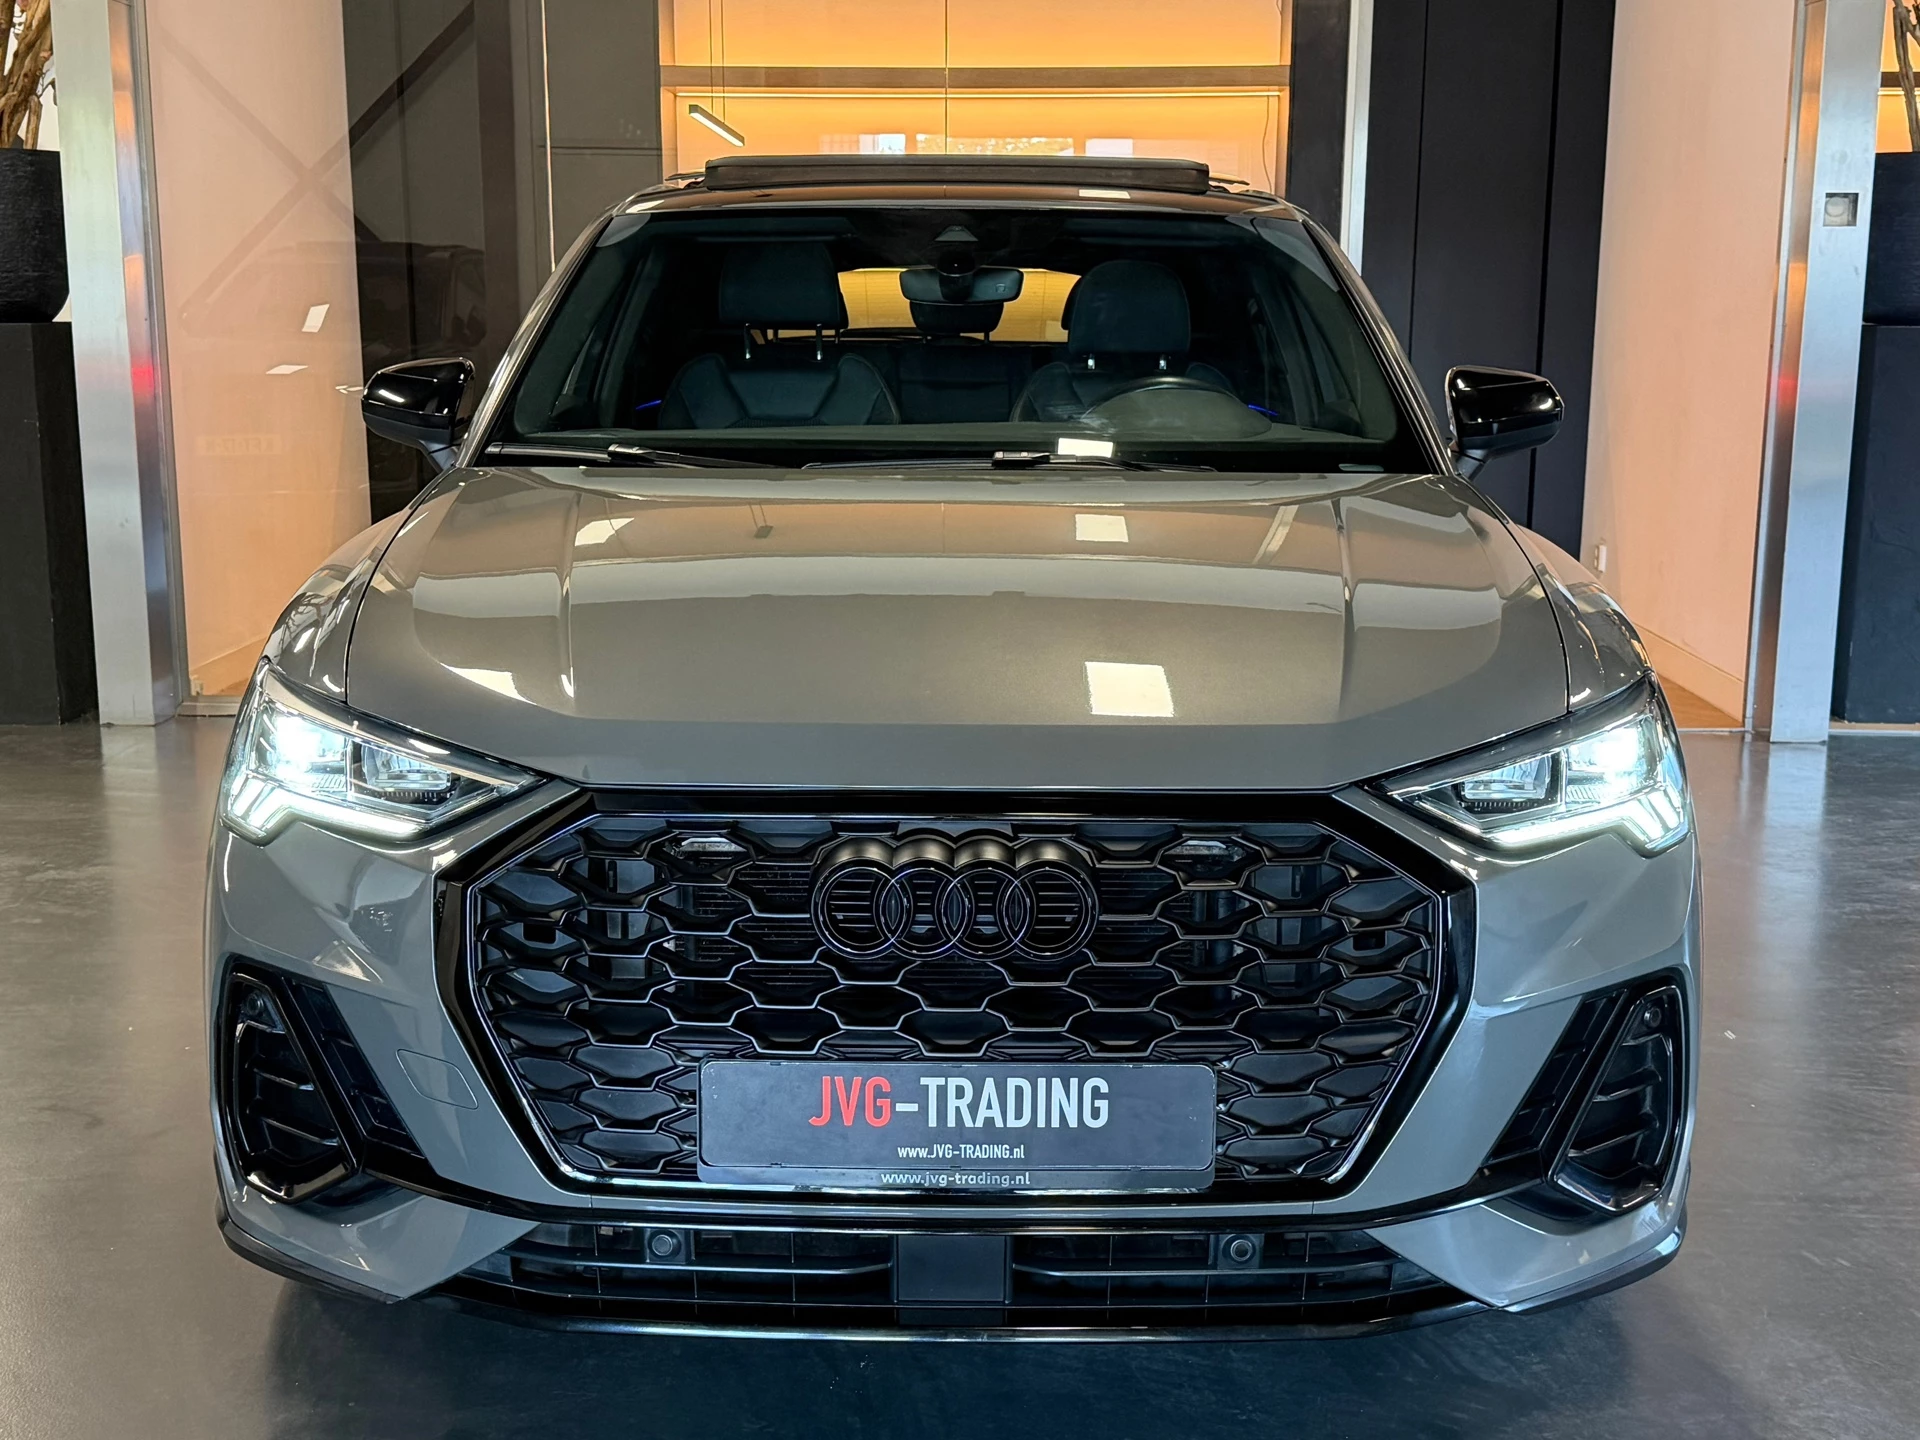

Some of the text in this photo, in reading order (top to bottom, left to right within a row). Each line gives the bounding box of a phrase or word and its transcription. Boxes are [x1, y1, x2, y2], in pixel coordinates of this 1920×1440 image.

[809, 1075, 1109, 1129] JVG-TRADING
[897, 1143, 1025, 1159] www.JVG-TRADING.nl
[881, 1171, 1031, 1187] www.jvg-trading.nl
